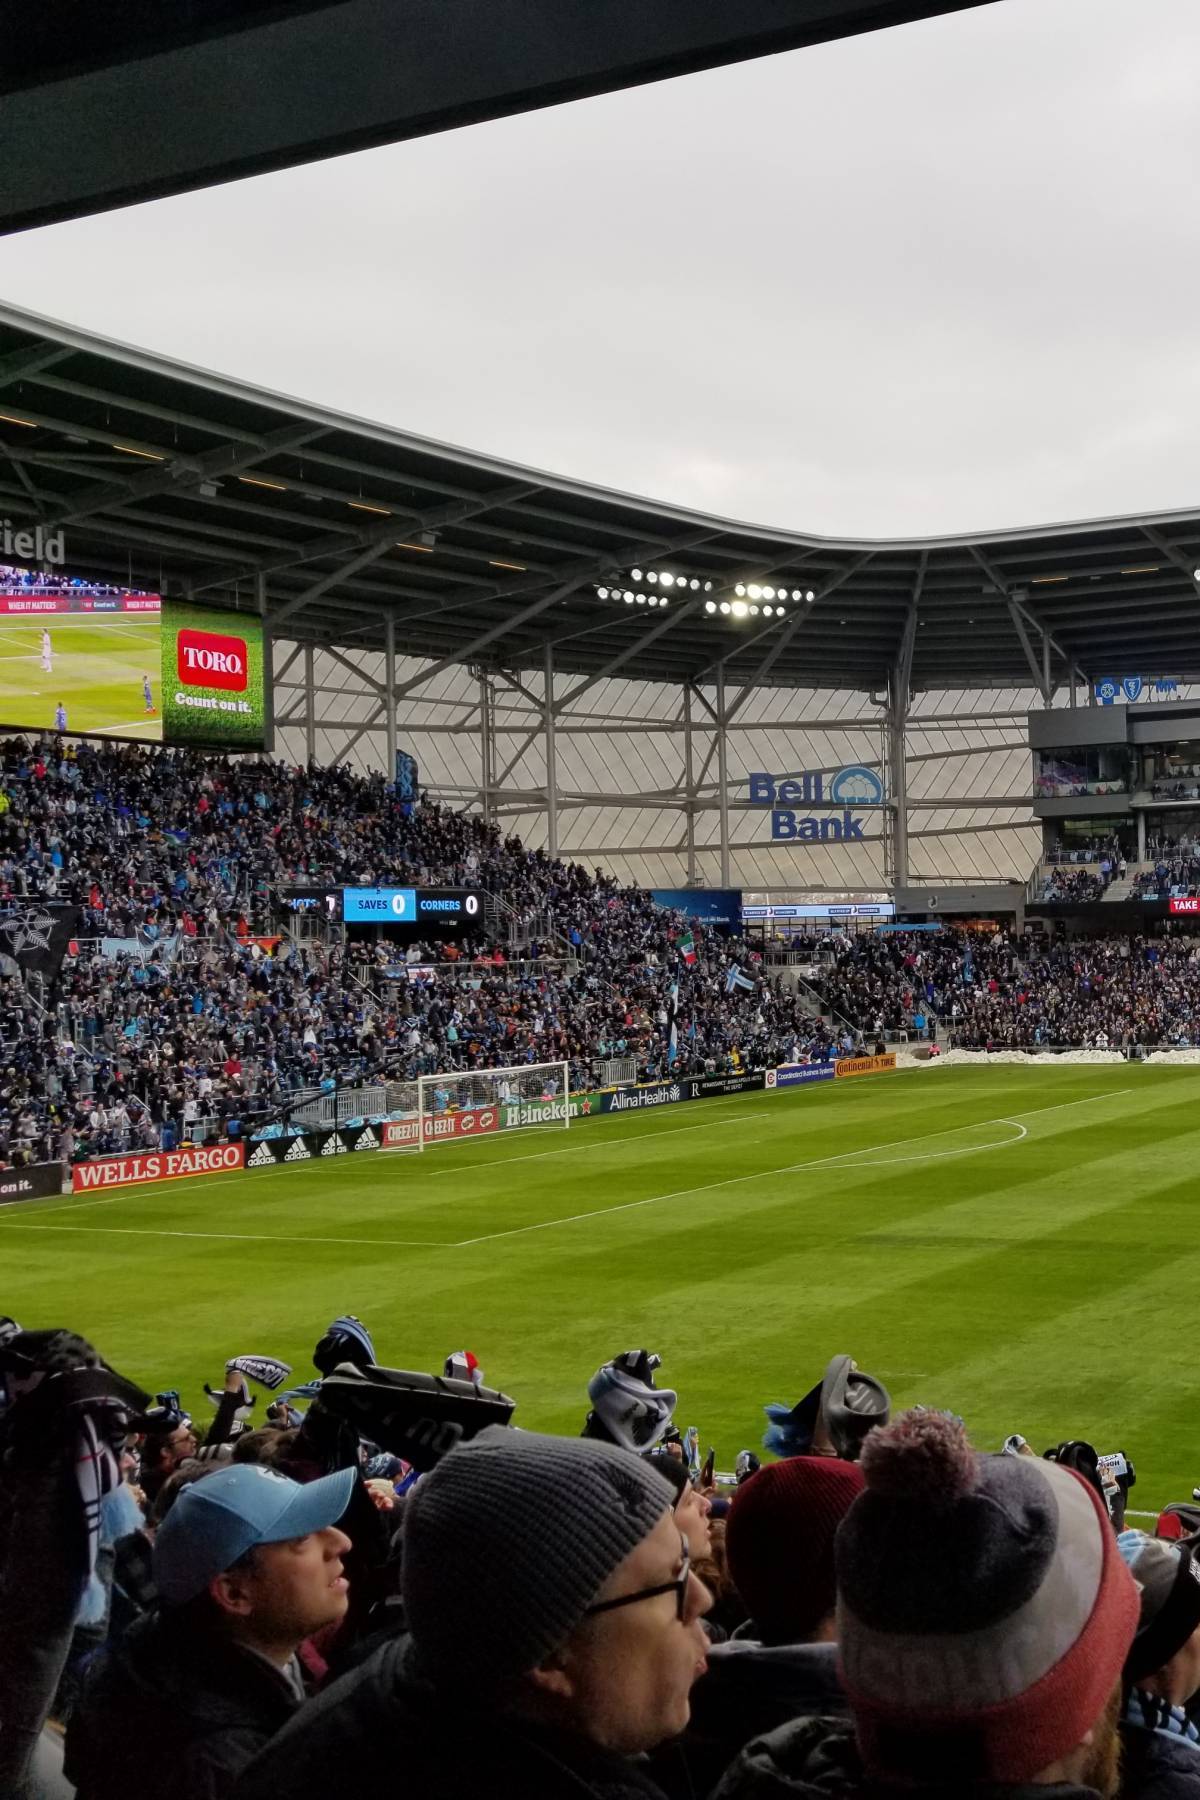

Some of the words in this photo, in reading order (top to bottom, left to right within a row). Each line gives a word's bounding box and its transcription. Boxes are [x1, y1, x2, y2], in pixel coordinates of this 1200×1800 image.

[0, 519, 65, 565] ield
[183, 646, 242, 674] TORO
[174, 692, 218, 708] Count
[219, 701, 236, 711] on
[238, 700, 252, 713] it.
[750, 772, 823, 804] Bell
[772, 810, 864, 840] Bank
[358, 900, 388, 910] SAVES
[392, 894, 406, 914] 0
[420, 900, 461, 911] CORNERS
[465, 895, 478, 914] 0
[1174, 900, 1198, 910] TAKE
[836, 1060, 874, 1076] Continental
[881, 1057, 894, 1067] TIRE
[506, 1101, 578, 1127] Heineken
[355, 1140, 380, 1151] adidas
[248, 1154, 276, 1167] adidas
[284, 1150, 311, 1162] adidas
[78, 1157, 160, 1187] WELLS
[166, 1146, 240, 1175] FARGO
[0, 1184, 18, 1194] on
